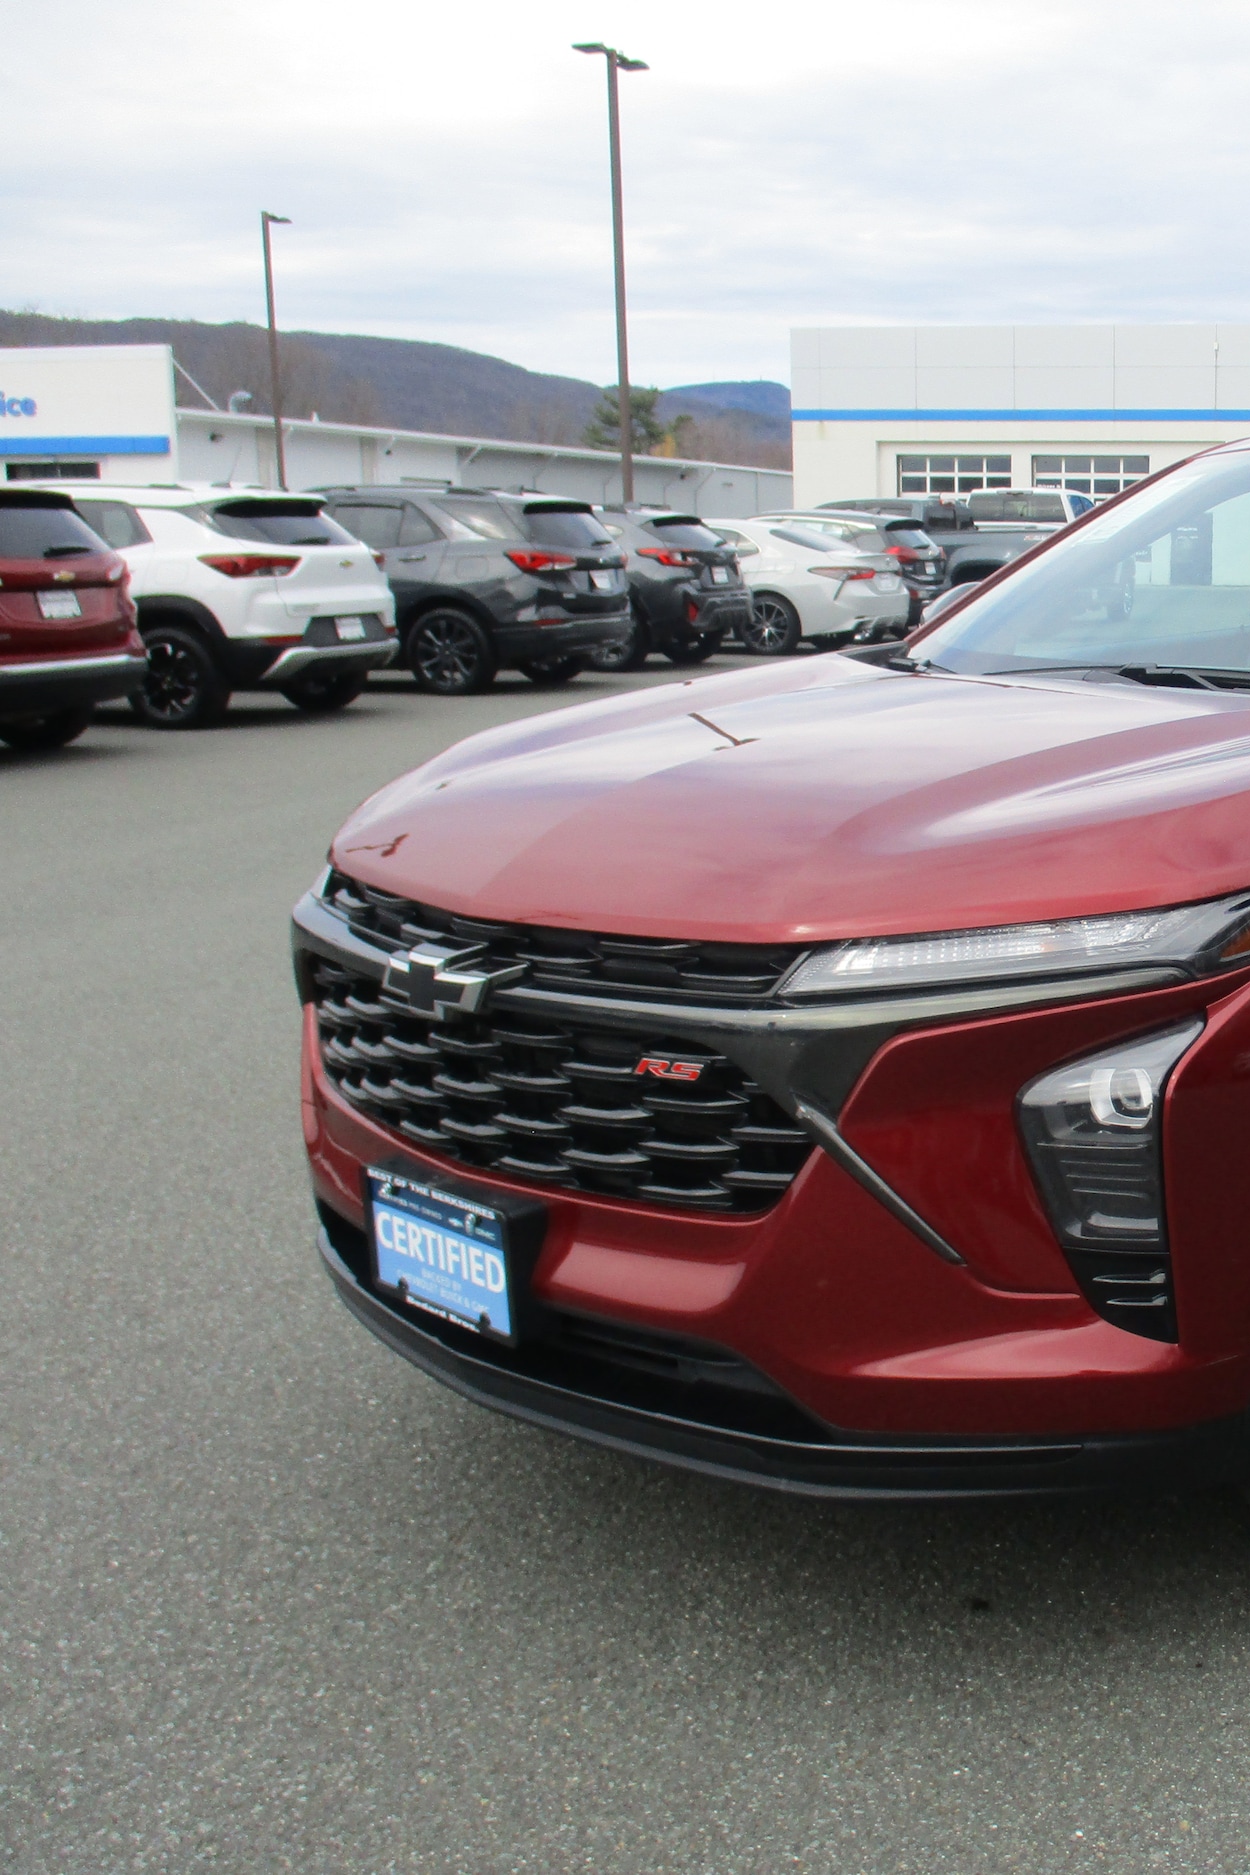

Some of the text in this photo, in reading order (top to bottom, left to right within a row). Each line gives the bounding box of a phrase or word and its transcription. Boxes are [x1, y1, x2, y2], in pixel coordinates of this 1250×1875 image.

[634, 1057, 704, 1081] RS
[408, 1182, 430, 1196] THE
[376, 1211, 506, 1294] CERTIFIED
